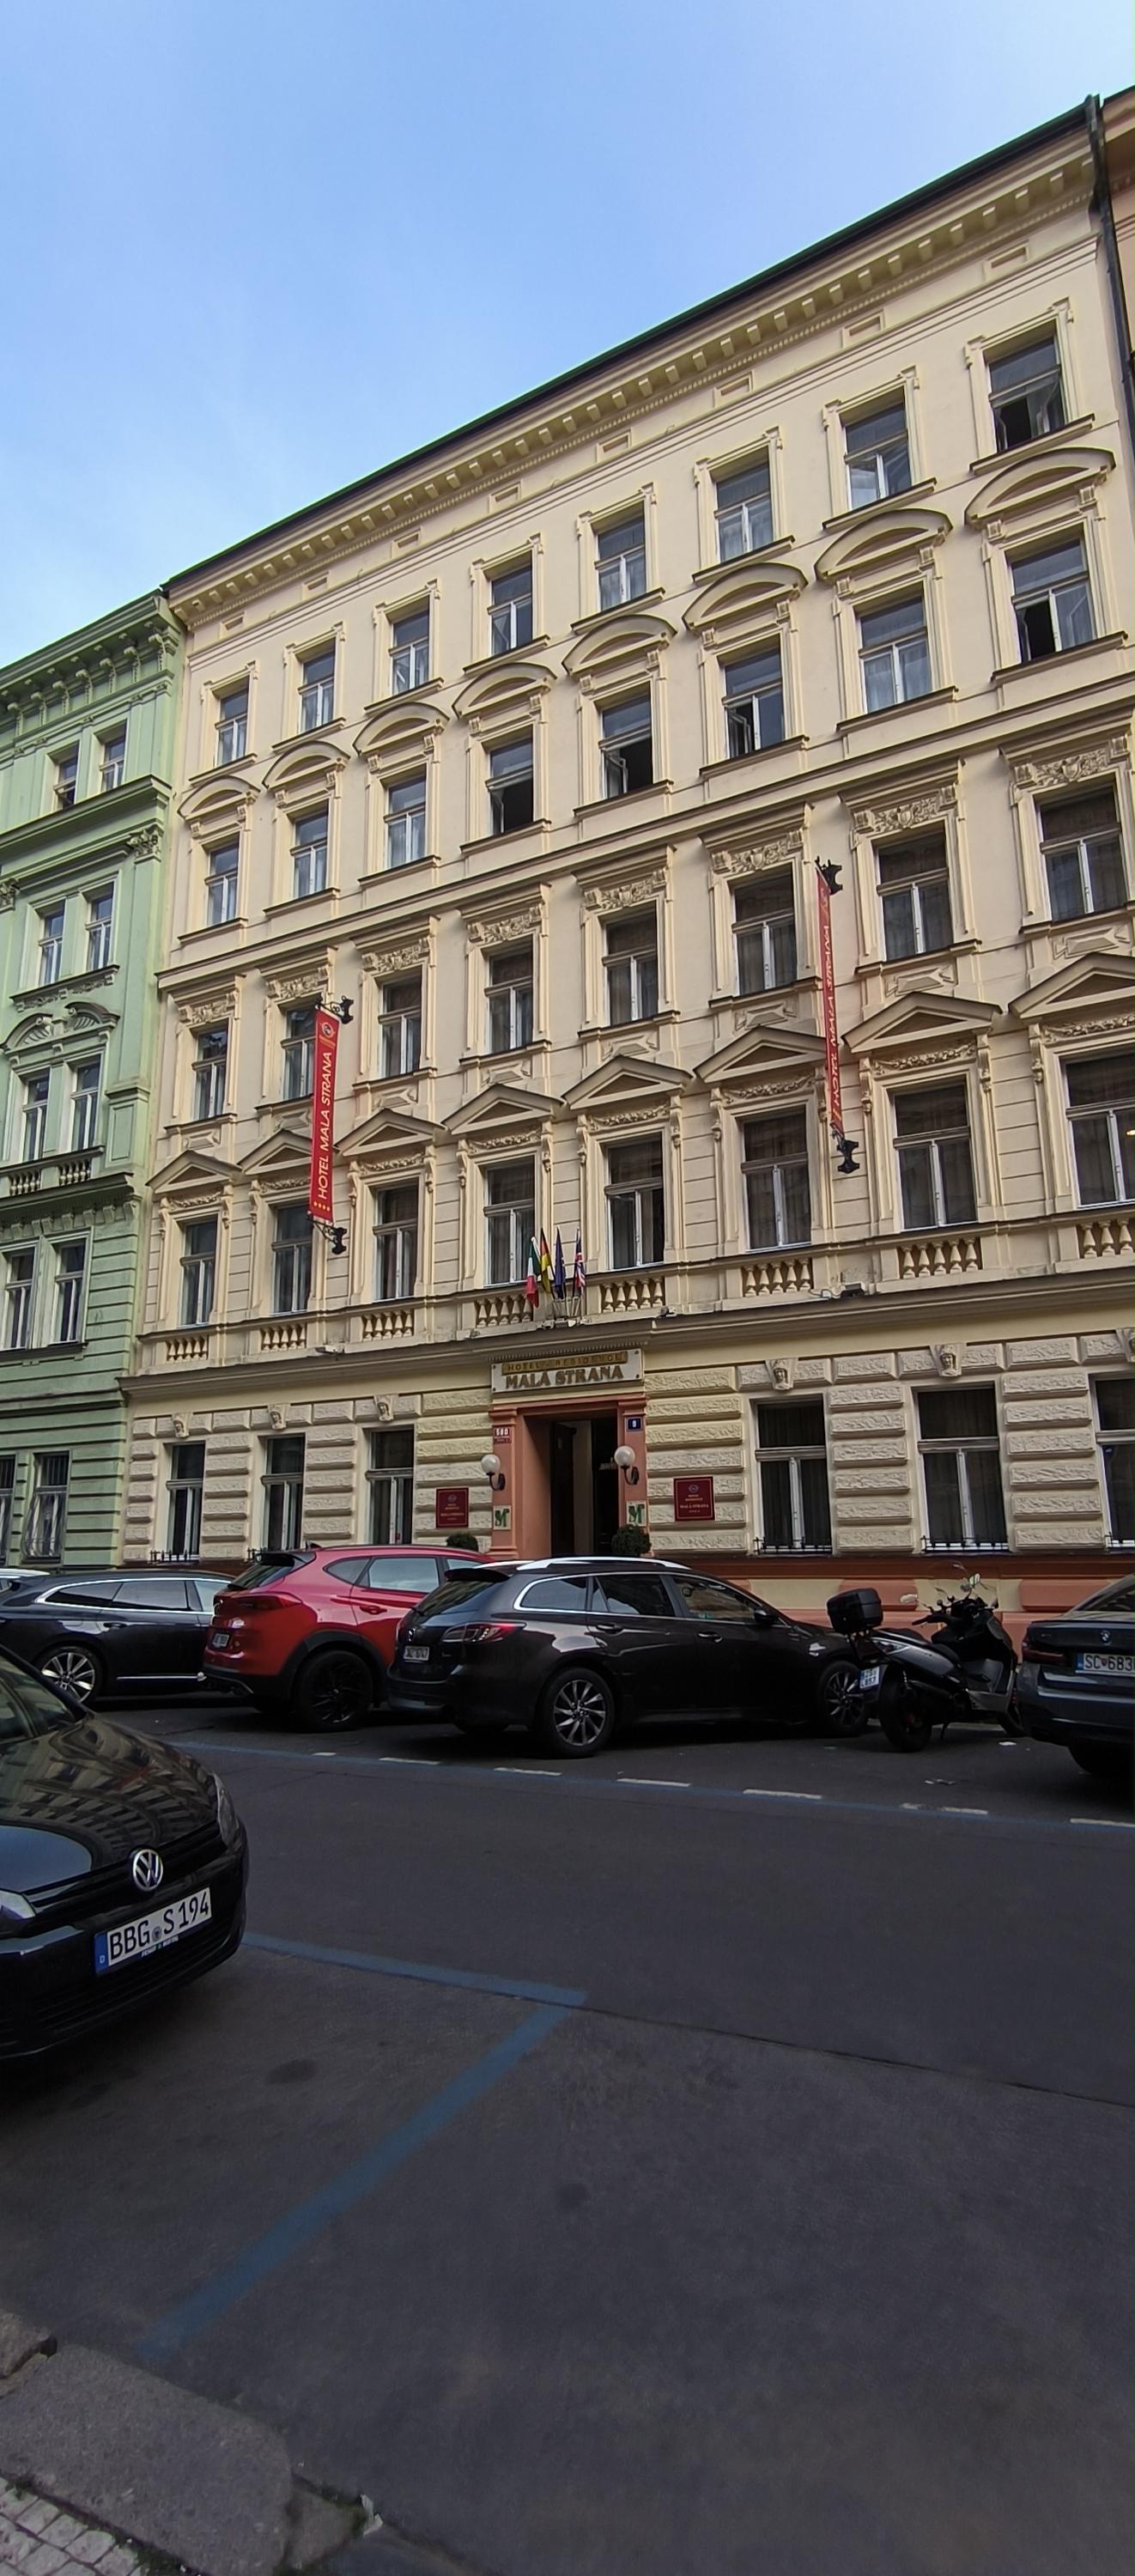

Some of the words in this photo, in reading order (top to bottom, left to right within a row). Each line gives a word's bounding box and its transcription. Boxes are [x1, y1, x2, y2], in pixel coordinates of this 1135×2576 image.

[321, 1052, 332, 1106] STRANA
[319, 1109, 331, 1151] MALA
[318, 1155, 330, 1200] HOTEL
[507, 1362, 540, 1371] HOTEL
[555, 1365, 624, 1385] STRANA
[1085, 1655, 1101, 1669] SC
[1108, 1656, 1133, 1672] 683
[109, 1919, 150, 1960] BBG
[163, 1908, 175, 1935] S
[179, 1891, 209, 1929] 194
